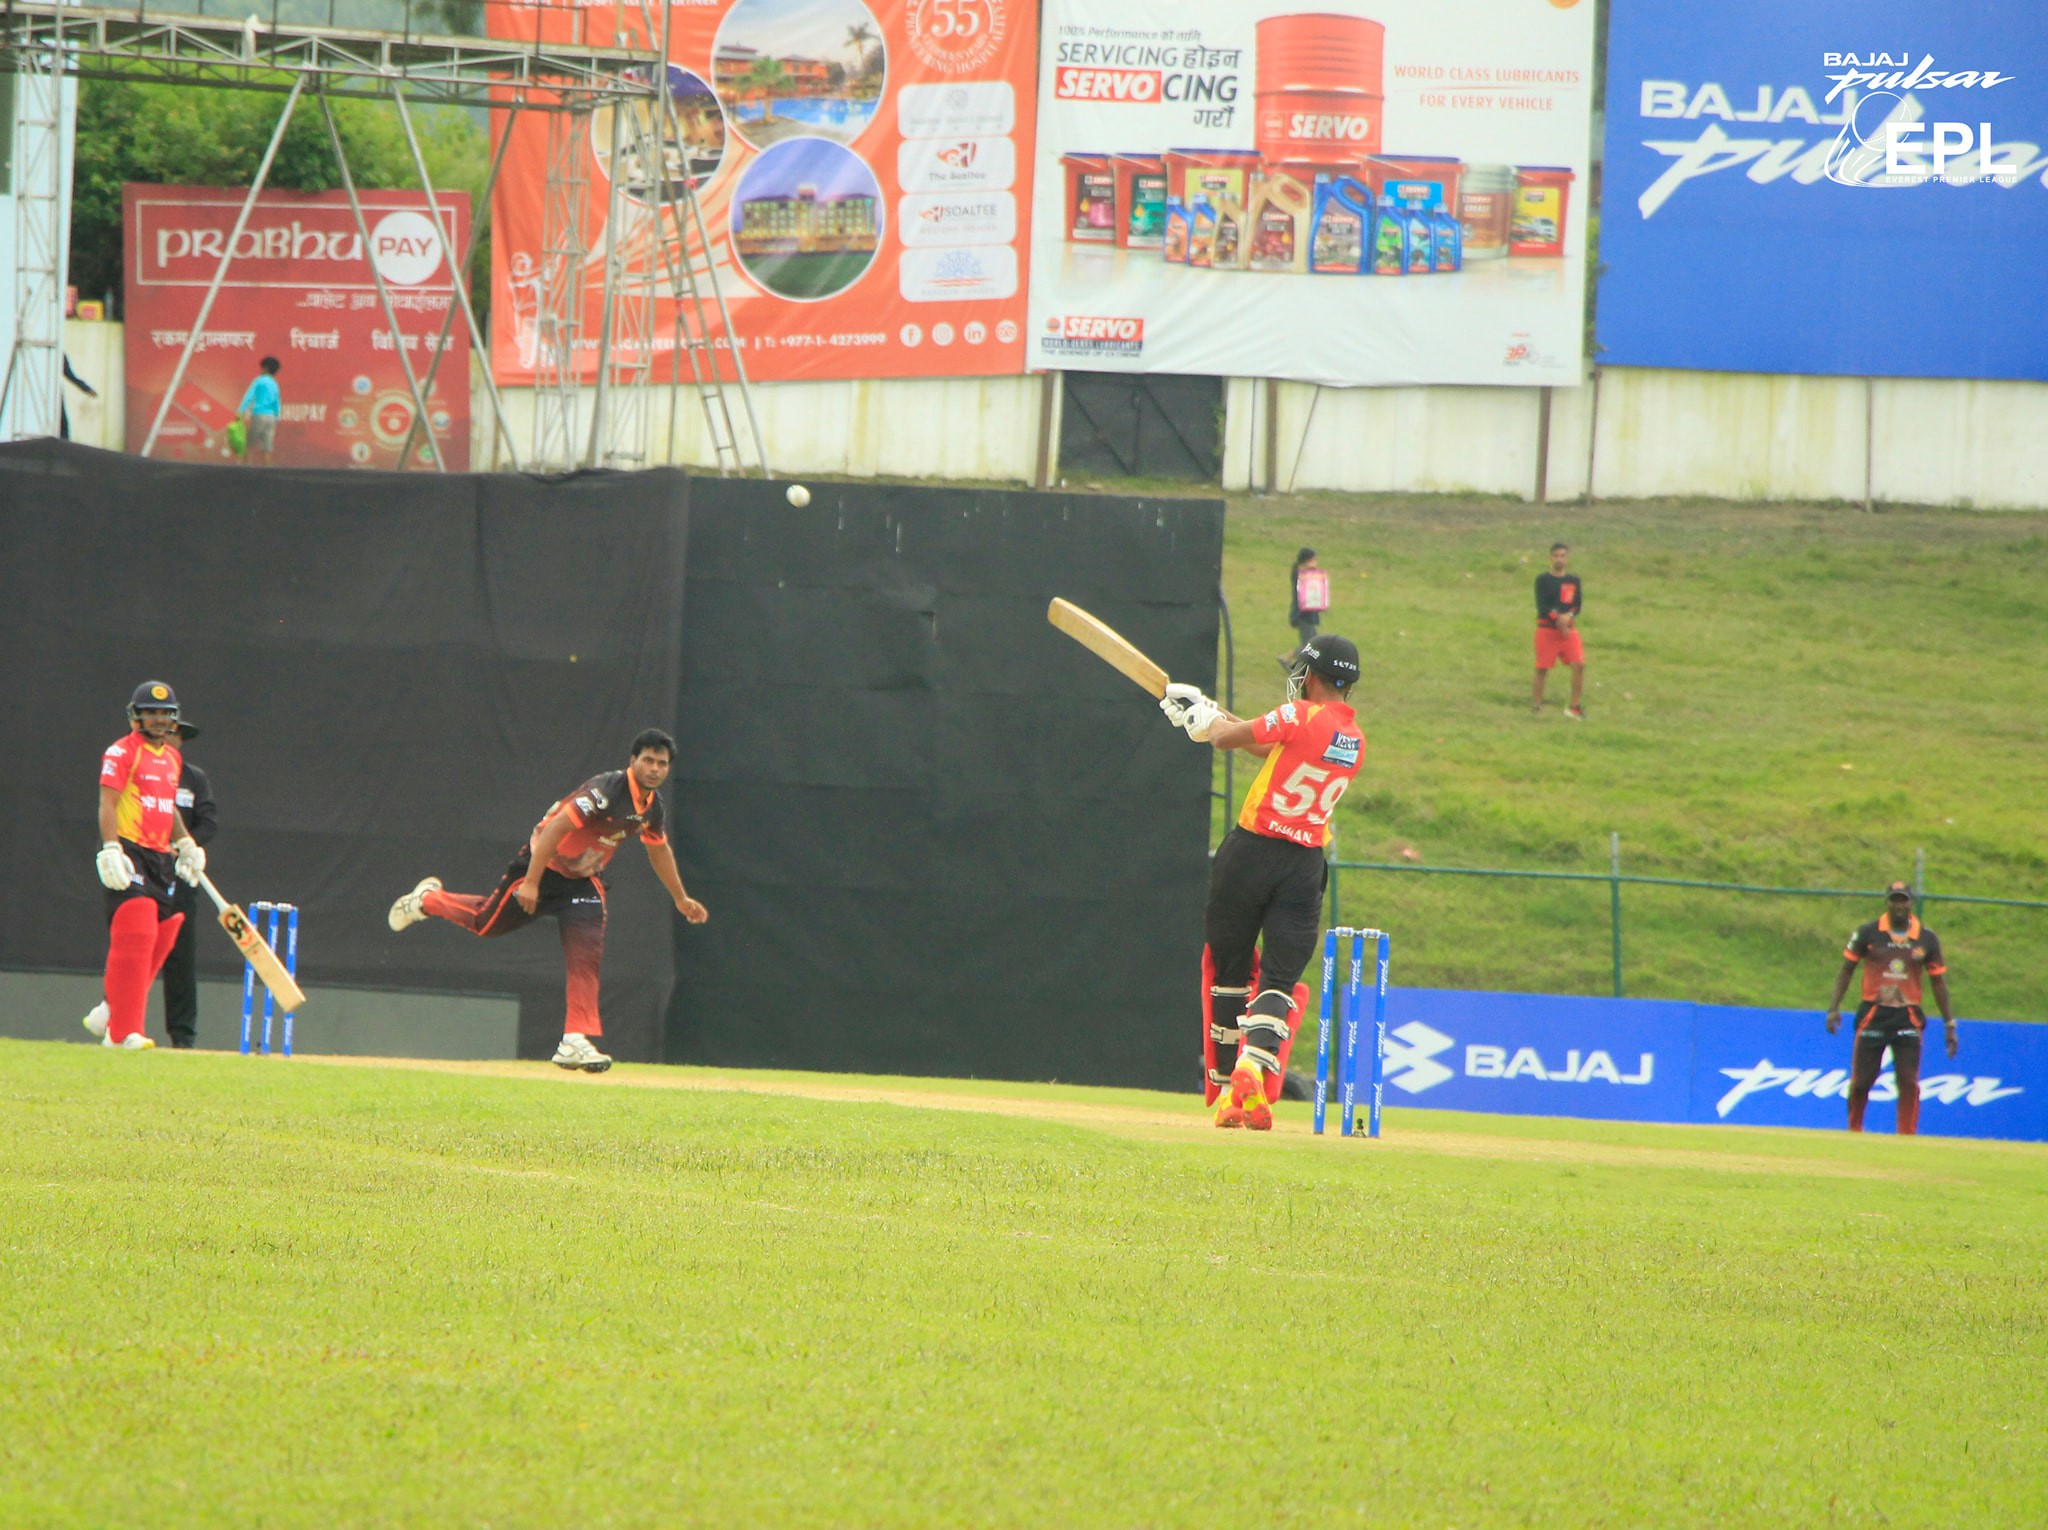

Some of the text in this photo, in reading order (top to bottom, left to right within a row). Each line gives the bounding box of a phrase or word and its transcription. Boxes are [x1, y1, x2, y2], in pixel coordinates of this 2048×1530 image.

[931, 0, 980, 37] 55
[1088, 27, 1158, 40] Performance
[1056, 42, 1242, 70] SERVICING होइन
[1057, 69, 1155, 101] SERVO
[1394, 65, 1580, 84] WORLD CLASS LUBRICANTS
[1419, 94, 1553, 111] FOR EVERY VEHICLE
[1639, 80, 1859, 125] BAJAJ
[1288, 113, 1370, 141] SERVO
[1637, 93, 2048, 220] pulsa
[944, 204, 997, 218] SOALTEE
[378, 236, 433, 257] PAY
[1065, 317, 1137, 339] SERVO
[1270, 761, 1350, 825] 59
[1464, 1043, 1654, 1085] BAJAJ
